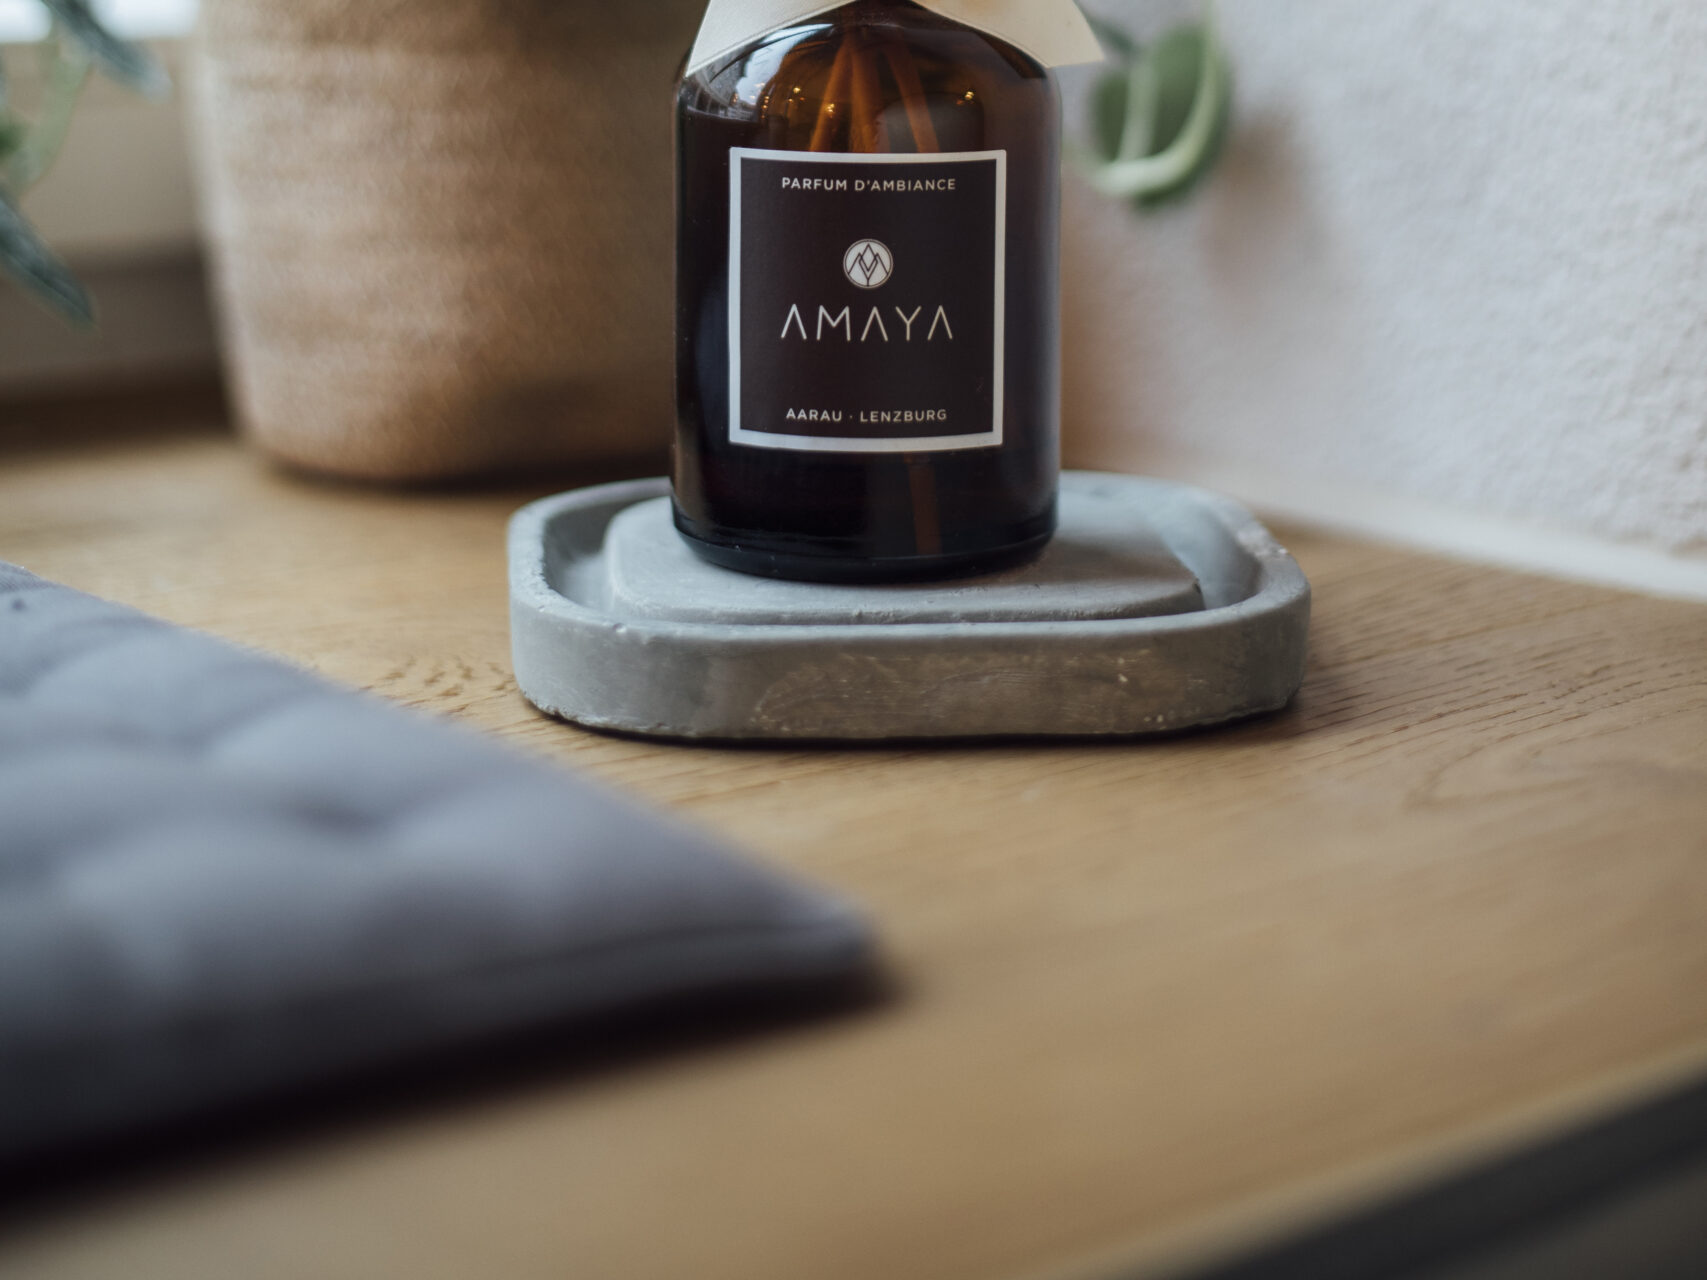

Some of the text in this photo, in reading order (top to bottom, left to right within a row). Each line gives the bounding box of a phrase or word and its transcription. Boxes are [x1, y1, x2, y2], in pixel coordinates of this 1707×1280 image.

[780, 176, 957, 191] PARFUM D'AMBIANCE
[780, 303, 954, 341] AMAYA
[785, 407, 949, 422] AARAU LENZBURG
